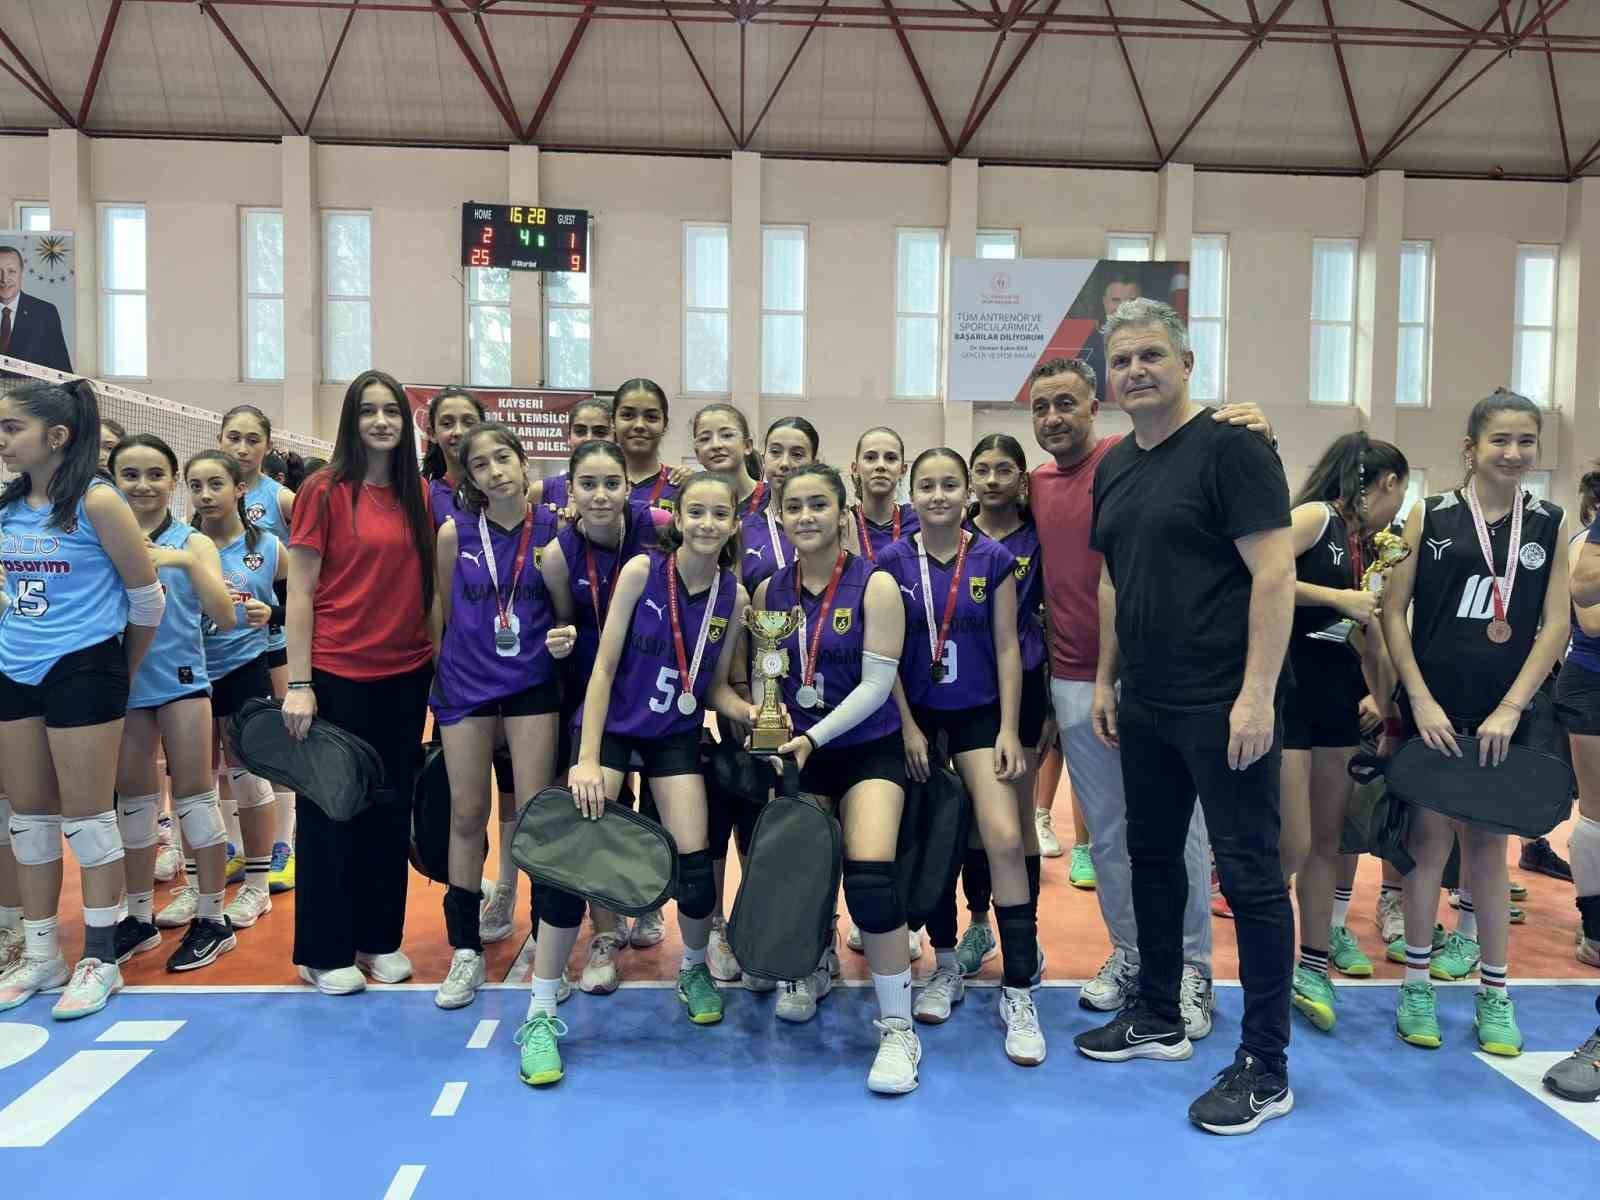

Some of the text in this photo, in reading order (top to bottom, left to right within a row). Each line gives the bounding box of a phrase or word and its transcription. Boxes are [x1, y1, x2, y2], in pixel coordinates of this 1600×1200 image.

[474, 208, 492, 220] HOME
[510, 207, 546, 225] 16 28
[557, 214, 576, 225] GUEST
[483, 227, 492, 243] 2
[520, 229, 530, 246] 4
[471, 249, 489, 265] 25
[571, 254, 580, 271] 9
[498, 397, 544, 409] KAYSERİ
[484, 411, 504, 422] BOL
[520, 411, 569, 424] TEMSİLCİ
[13, 579, 49, 617] 15
[1456, 574, 1507, 620] 10
[648, 666, 680, 713] 5
